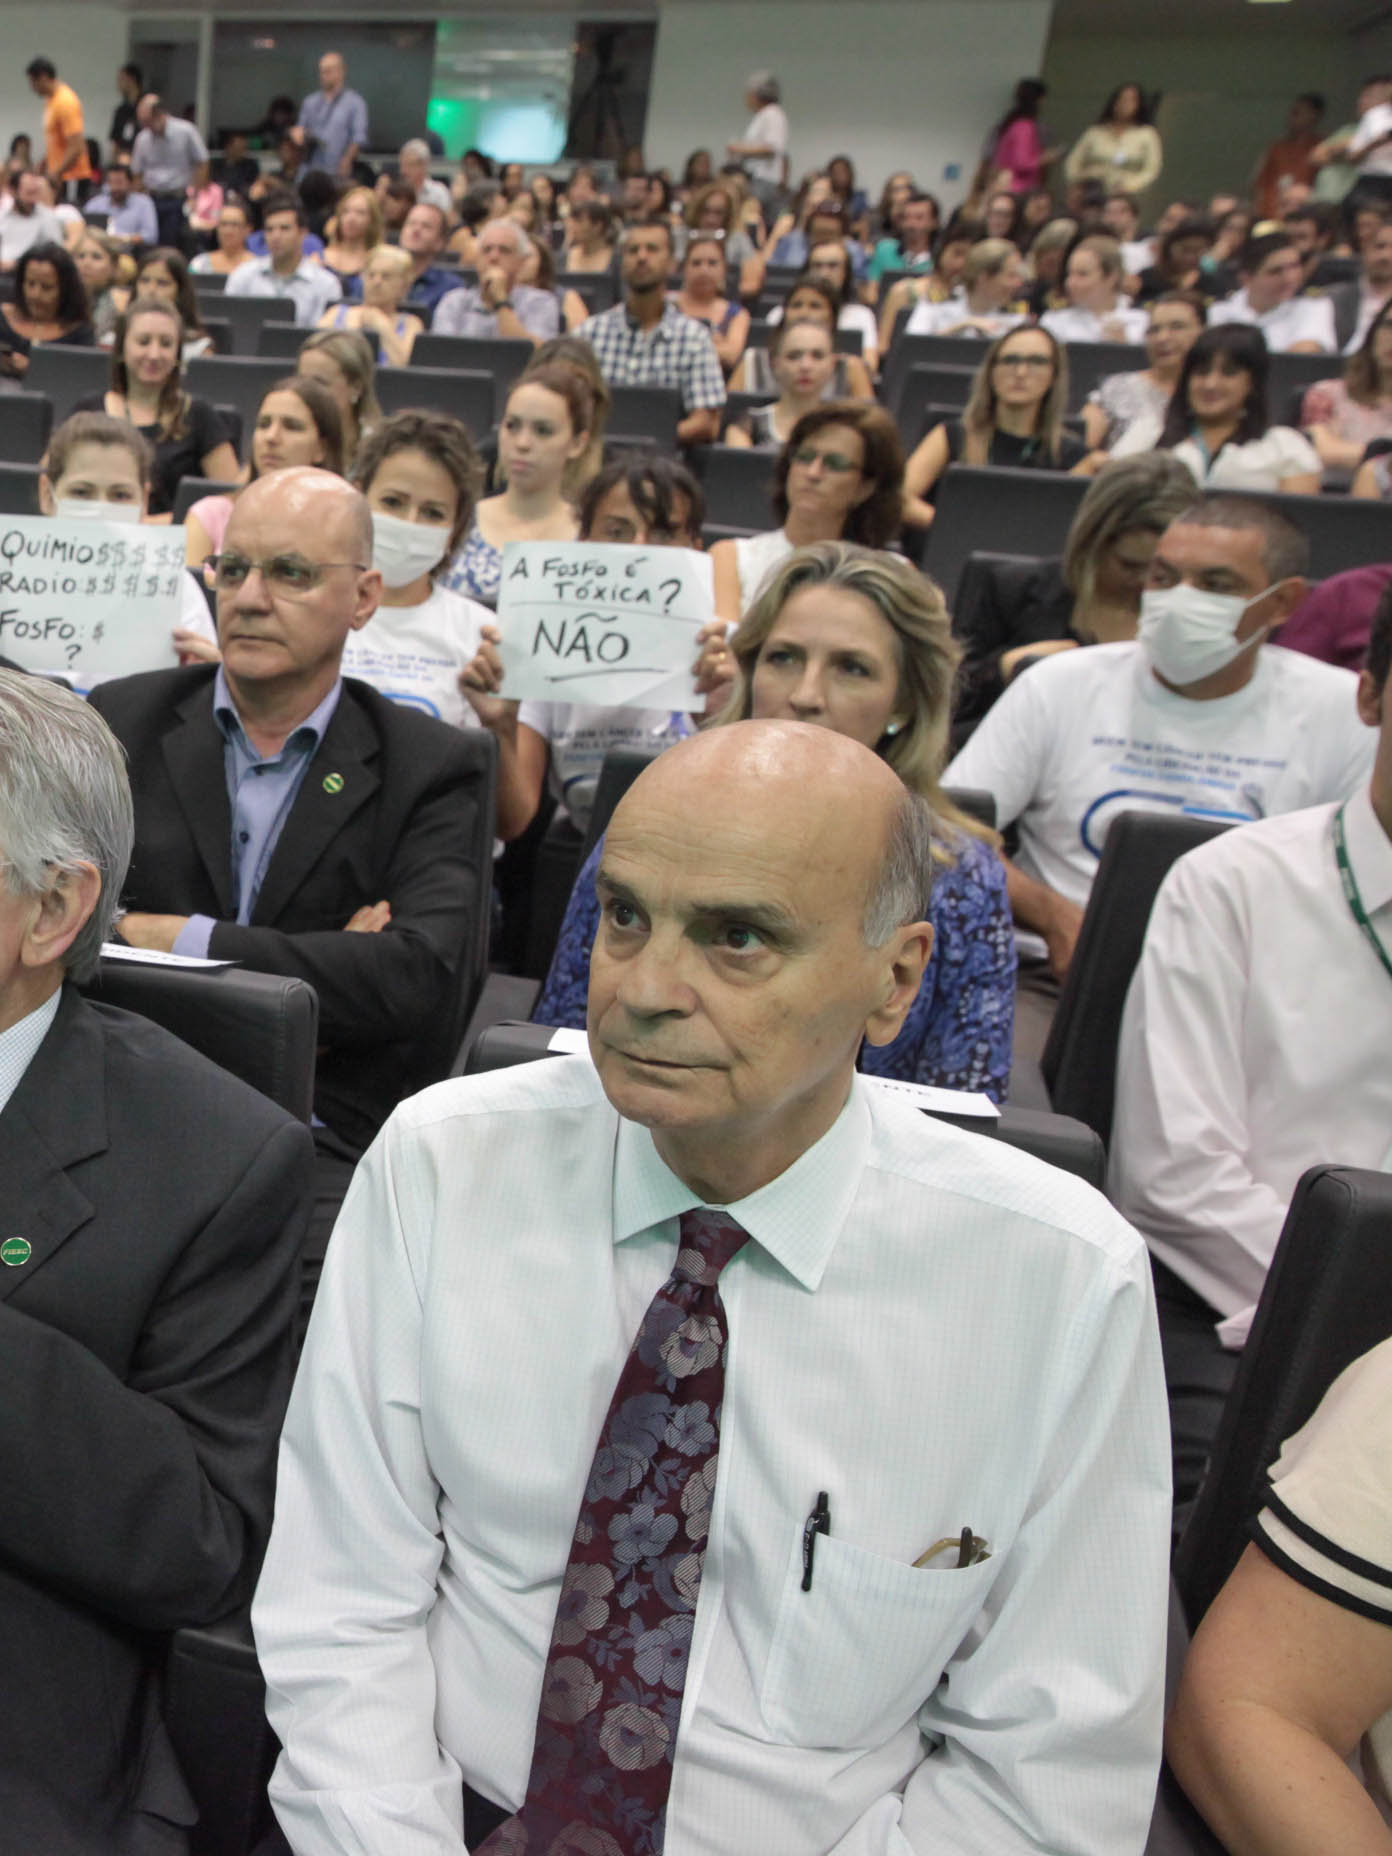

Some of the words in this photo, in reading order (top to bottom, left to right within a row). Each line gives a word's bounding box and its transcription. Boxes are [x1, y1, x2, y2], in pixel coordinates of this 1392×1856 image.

[509, 557, 529, 580] A
[542, 557, 608, 577] FOSFO
[554, 578, 682, 614] TÓXICA?
[531, 611, 630, 663] NÃO
[65, 643, 82, 669] ?
